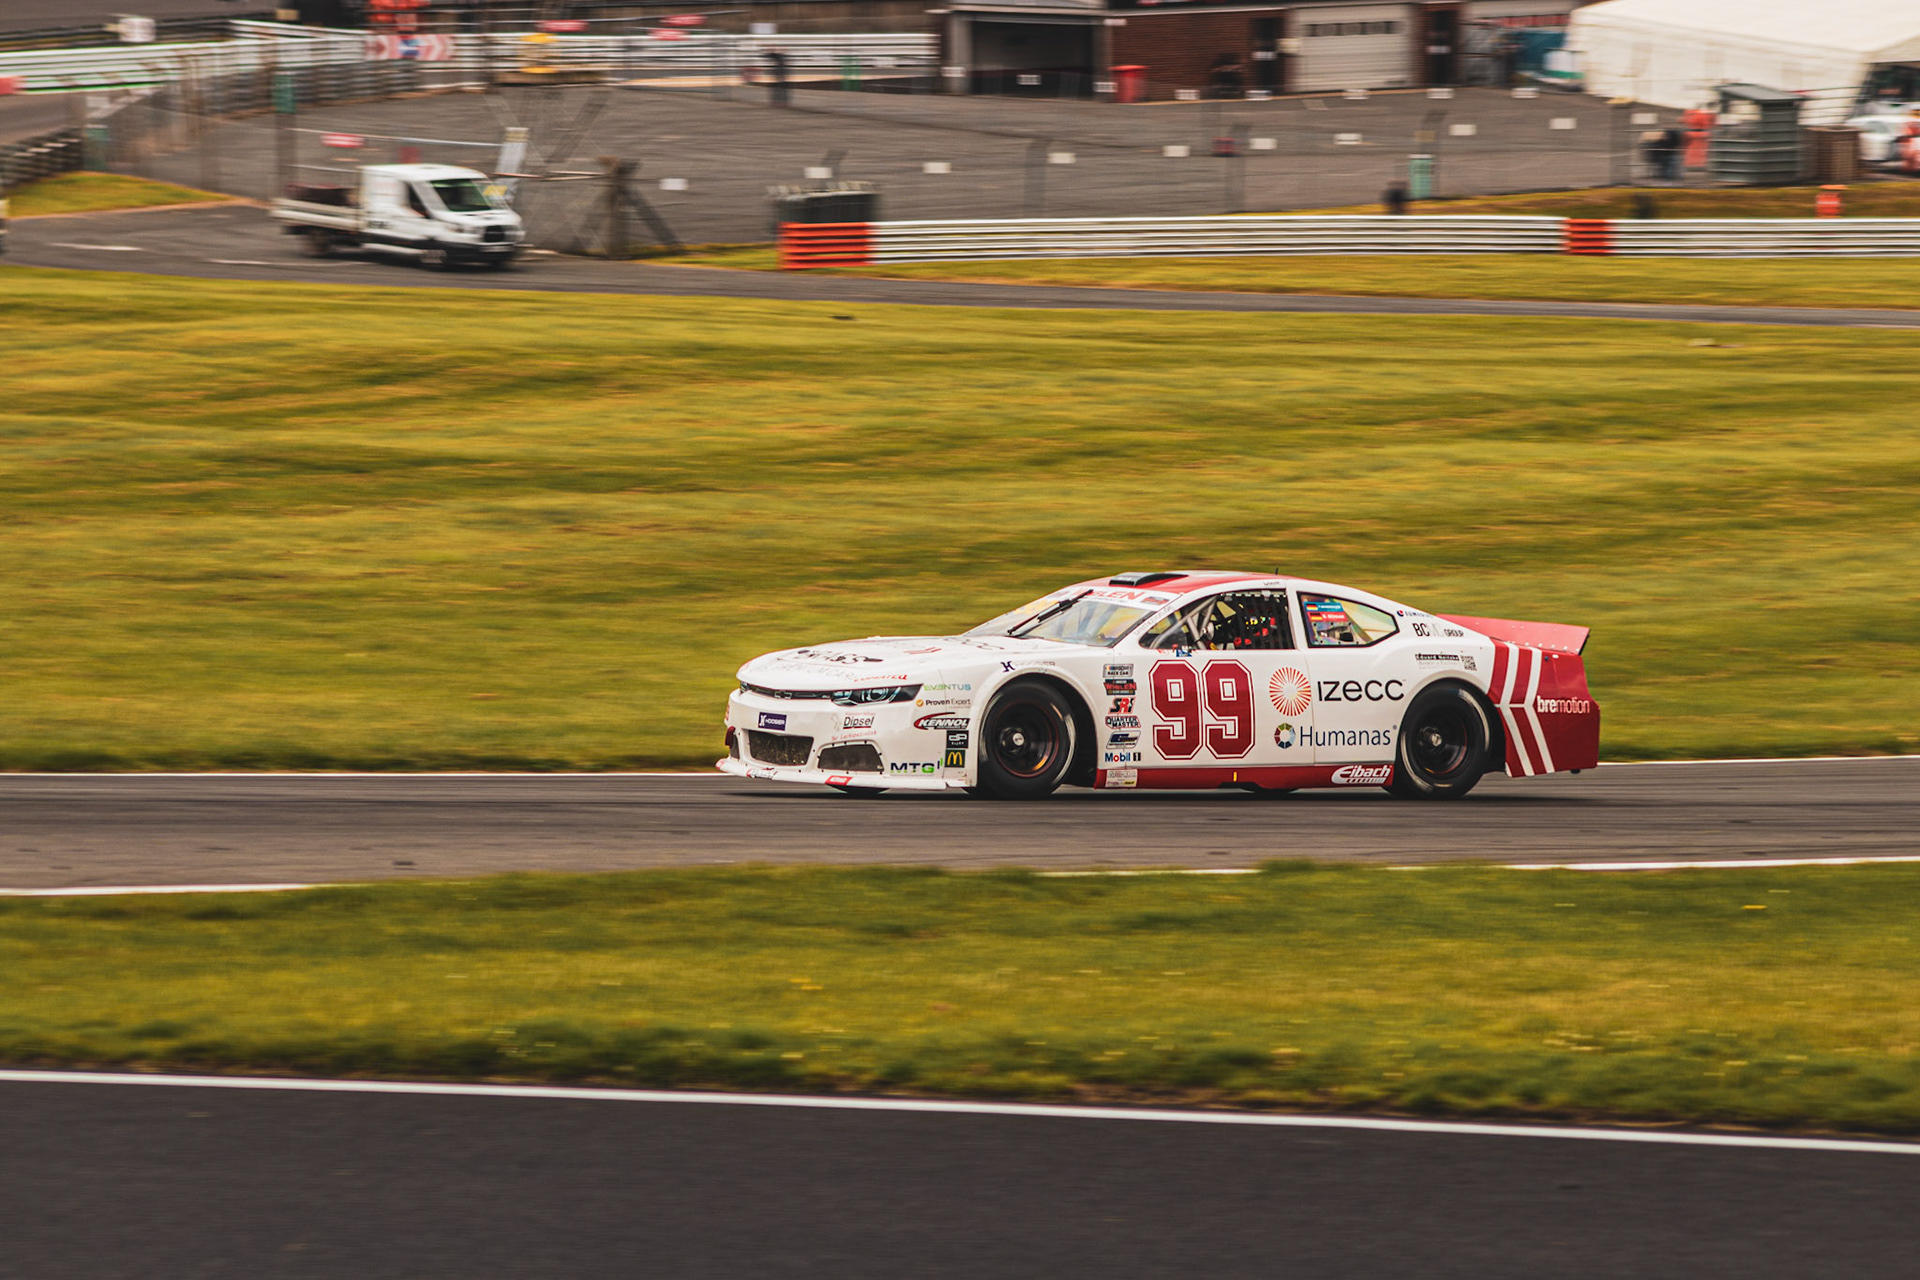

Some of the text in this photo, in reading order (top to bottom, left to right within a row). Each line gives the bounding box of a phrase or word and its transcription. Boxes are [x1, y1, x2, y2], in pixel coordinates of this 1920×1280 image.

[951, 698, 971, 706] Expert
[1537, 696, 1590, 714] bremotion
[1148, 659, 1256, 760] 99
[843, 716, 875, 727] Dipsel
[918, 719, 968, 728] KENNOL
[1300, 726, 1391, 747] Humanas
[1105, 753, 1131, 762] Mobil
[890, 763, 935, 774] MTG
[1331, 765, 1391, 784] Eibach
